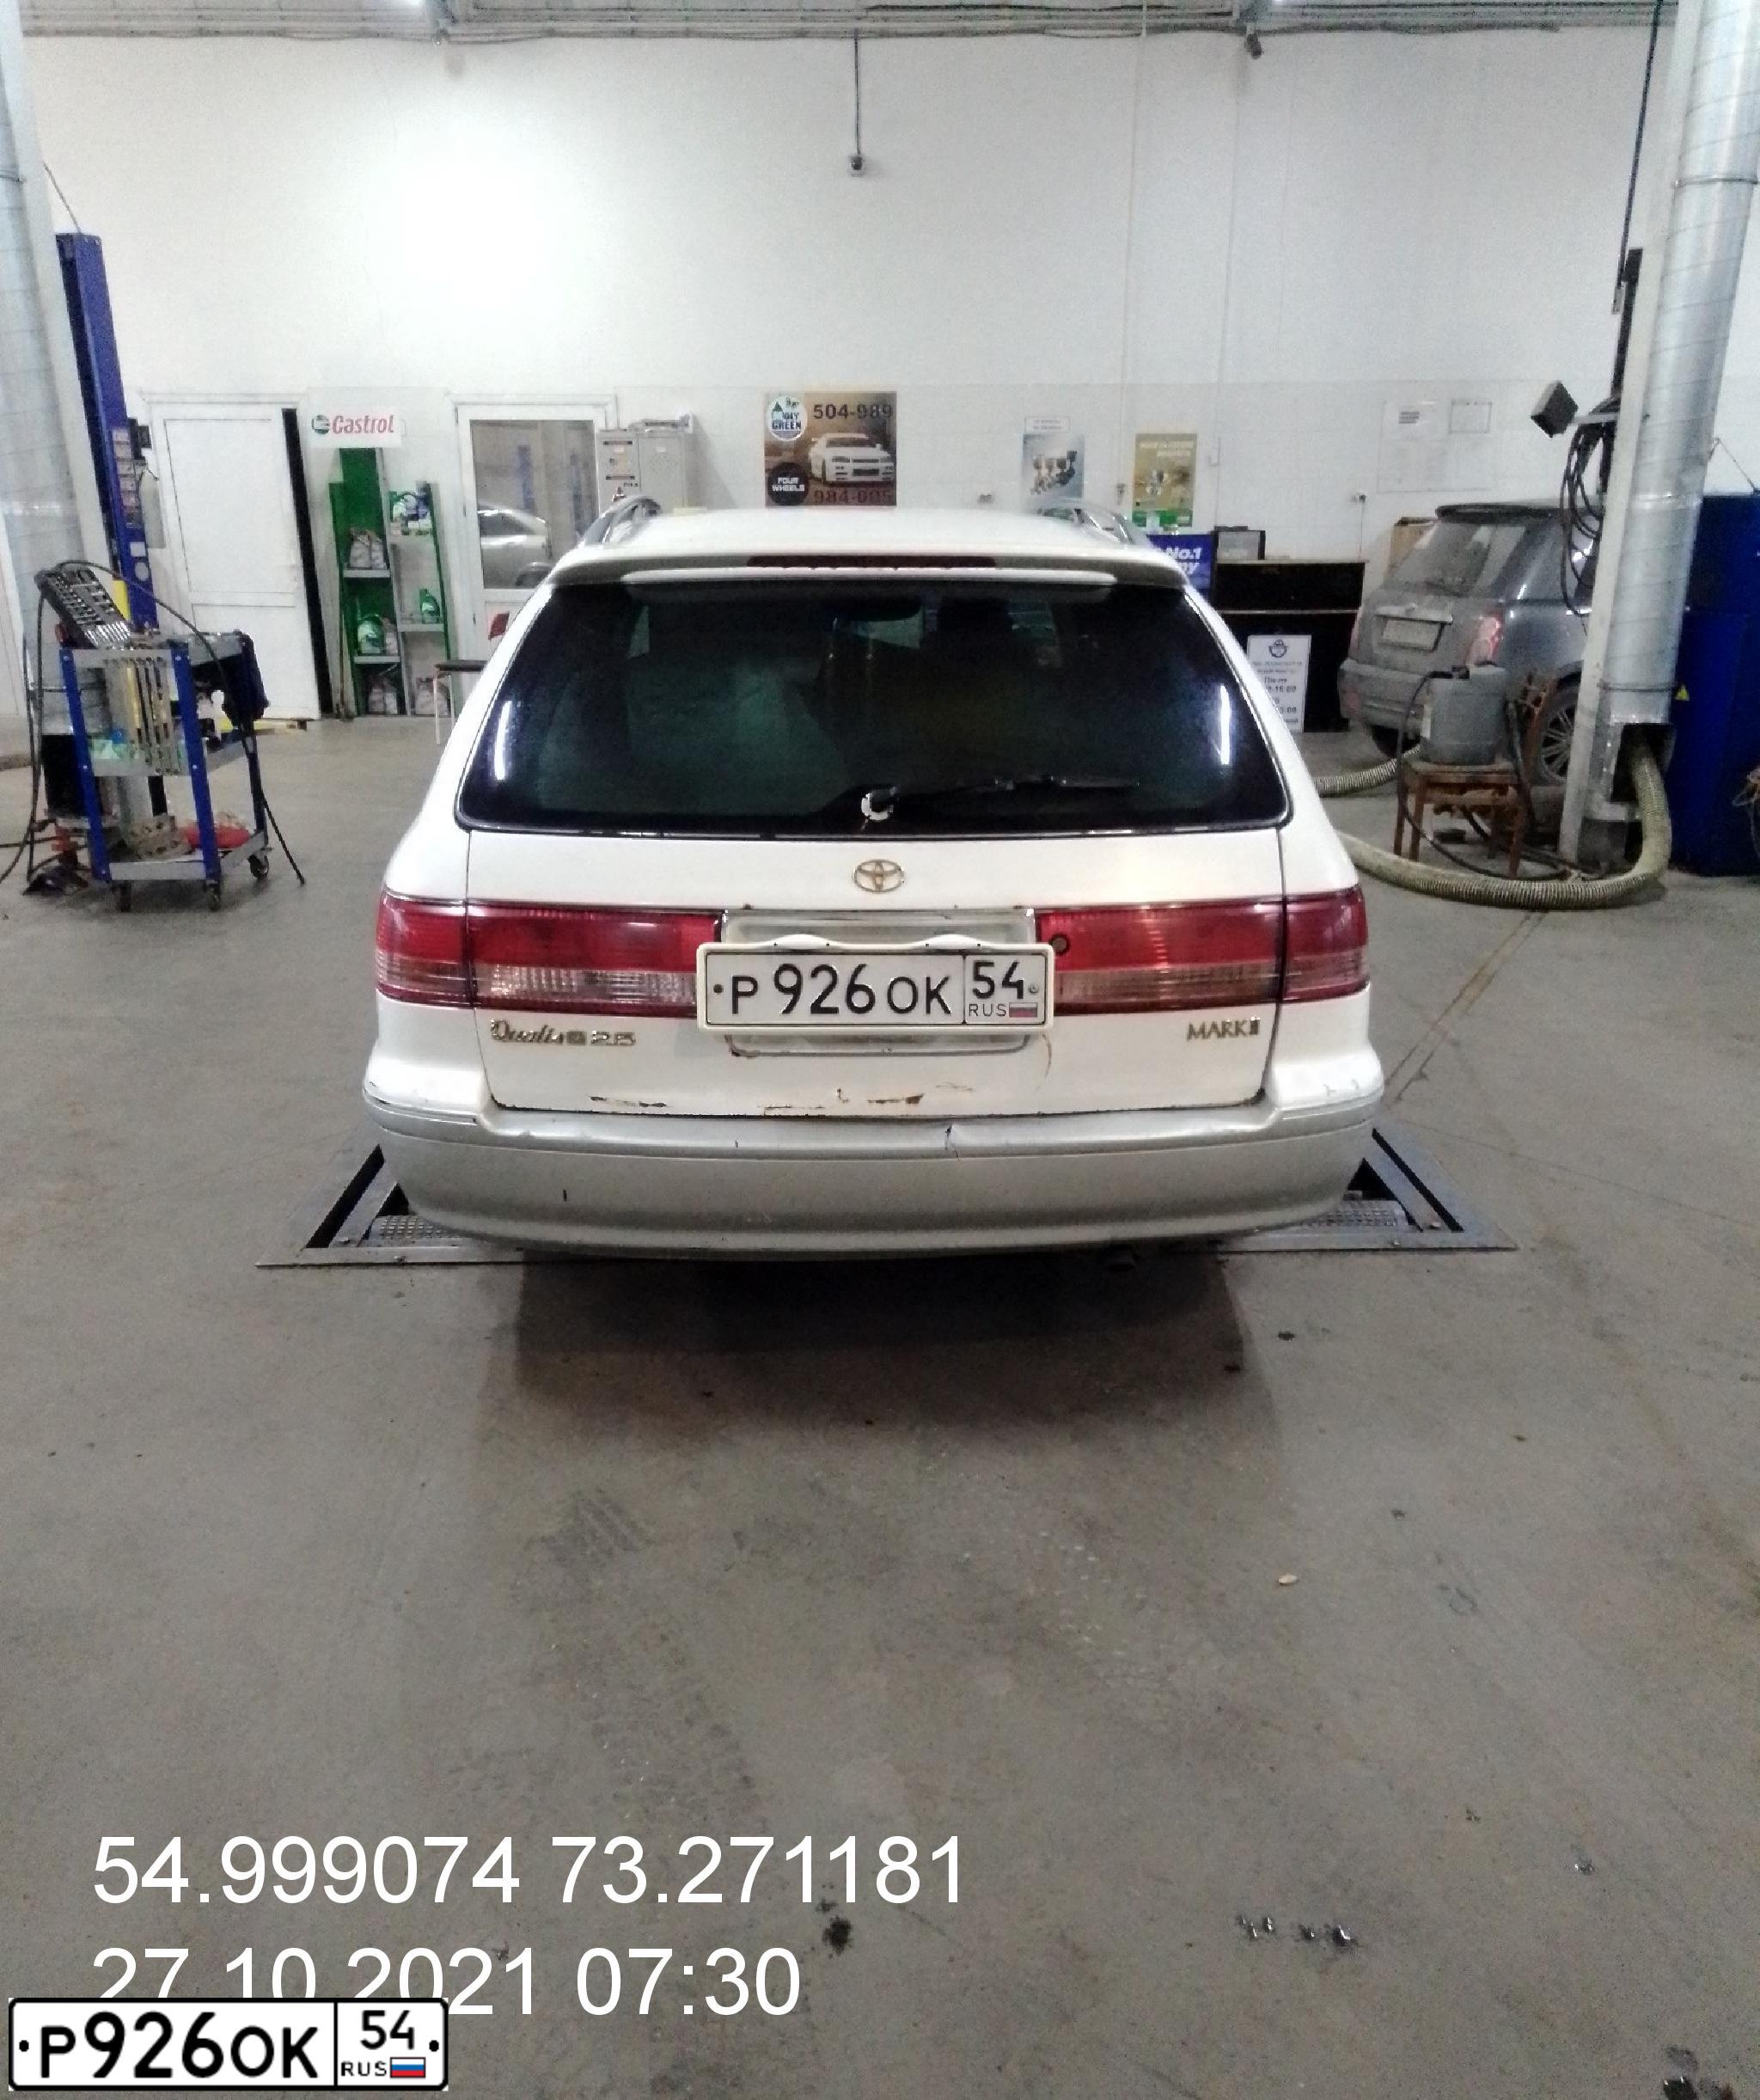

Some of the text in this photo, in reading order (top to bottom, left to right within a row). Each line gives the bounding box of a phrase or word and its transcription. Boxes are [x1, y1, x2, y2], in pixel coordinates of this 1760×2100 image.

[813, 403, 894, 419] 504-989
[332, 415, 394, 434] Castrol
[1165, 547, 1203, 560] No.1
[972, 960, 1024, 999] 54
[968, 1003, 1007, 1018] RUS
